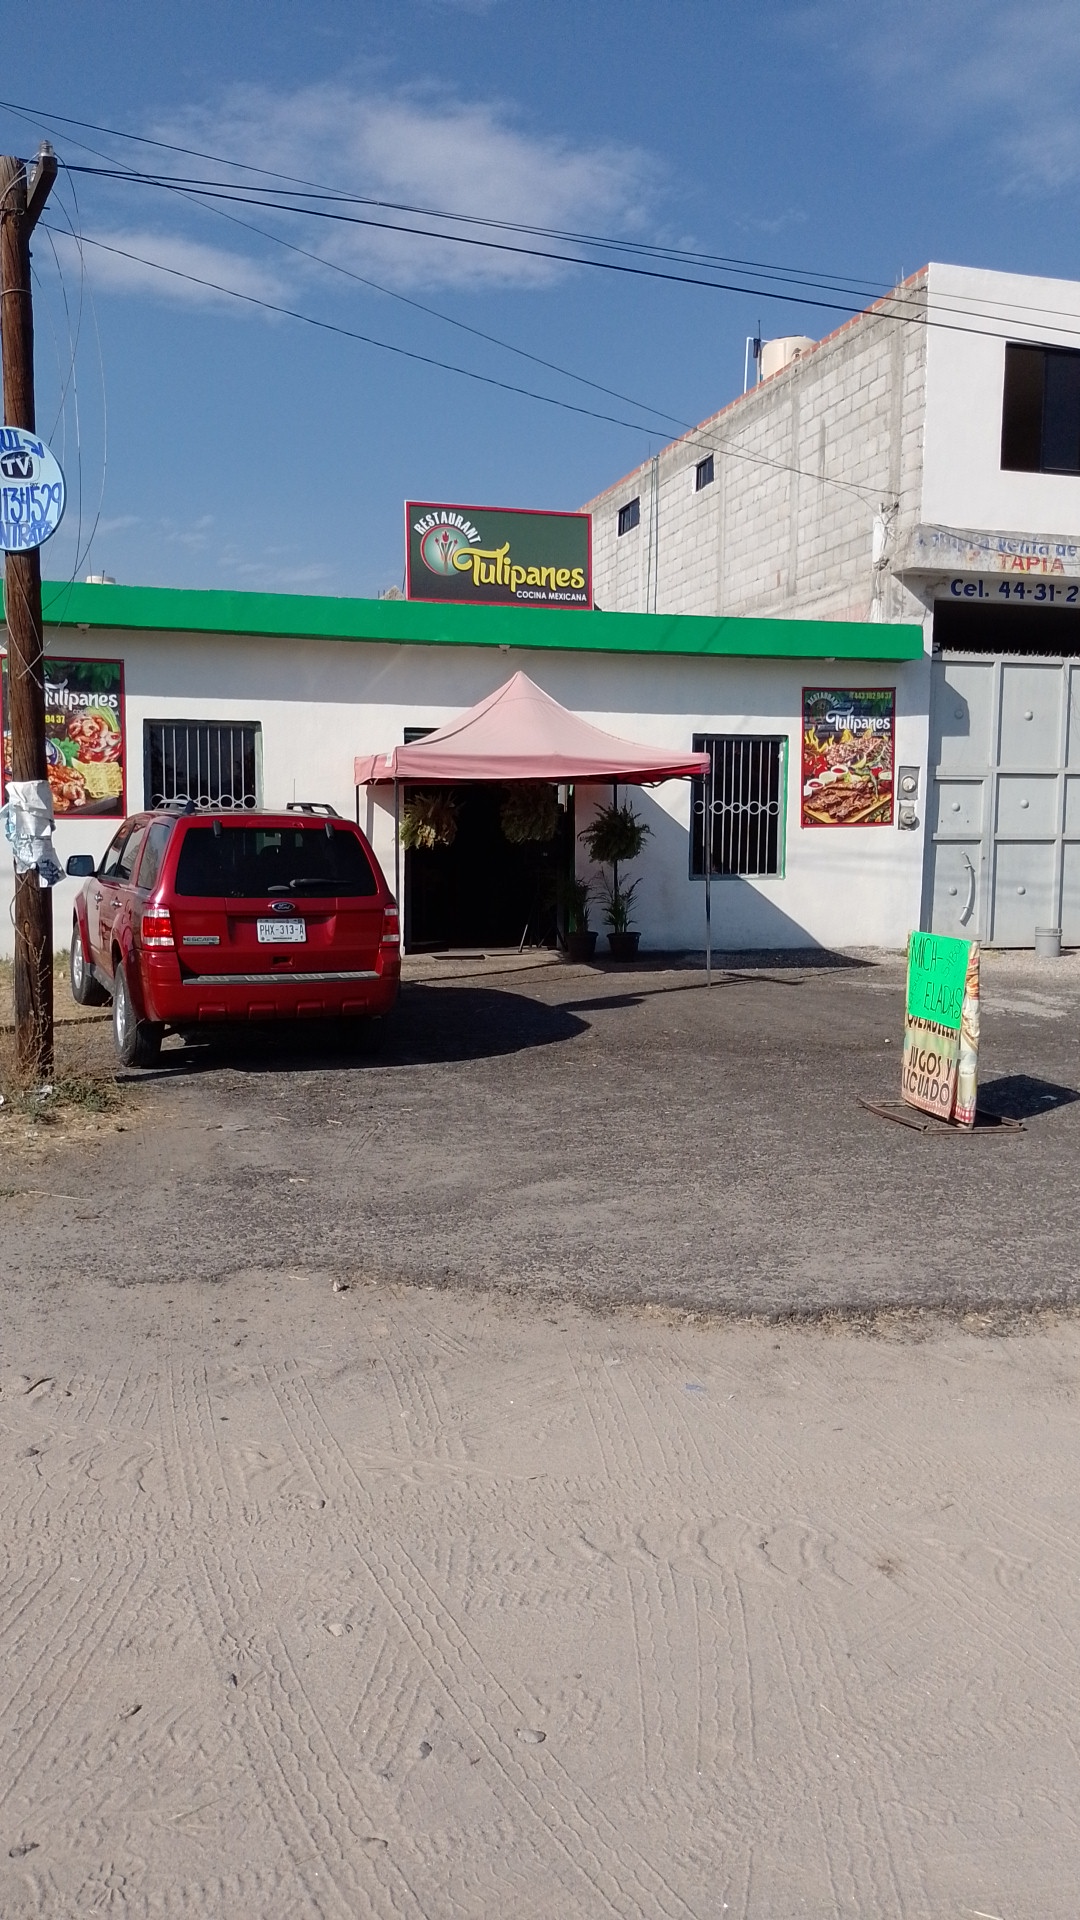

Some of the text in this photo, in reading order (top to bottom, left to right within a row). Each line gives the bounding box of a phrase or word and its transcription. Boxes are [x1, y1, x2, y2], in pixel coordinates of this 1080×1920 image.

[0, 429, 26, 452] UI
[2, 456, 30, 475] TV
[0, 482, 62, 523] 134529
[413, 511, 482, 544] RESTAURANT
[452, 542, 586, 592] Tulipanes
[998, 554, 1065, 573] TAPIA
[516, 590, 587, 602] COCINA MEXICANA
[951, 579, 1079, 603] Cel. 44-31-2
[44, 679, 118, 711] Tulipanes
[56, 714, 66, 724] 37
[826, 705, 891, 733] Tulipanes
[259, 924, 304, 936] PHX-313-A
[911, 936, 943, 972] MICH-
[924, 982, 963, 1020] ELADAS
[908, 1046, 953, 1081] JUGOS Y
